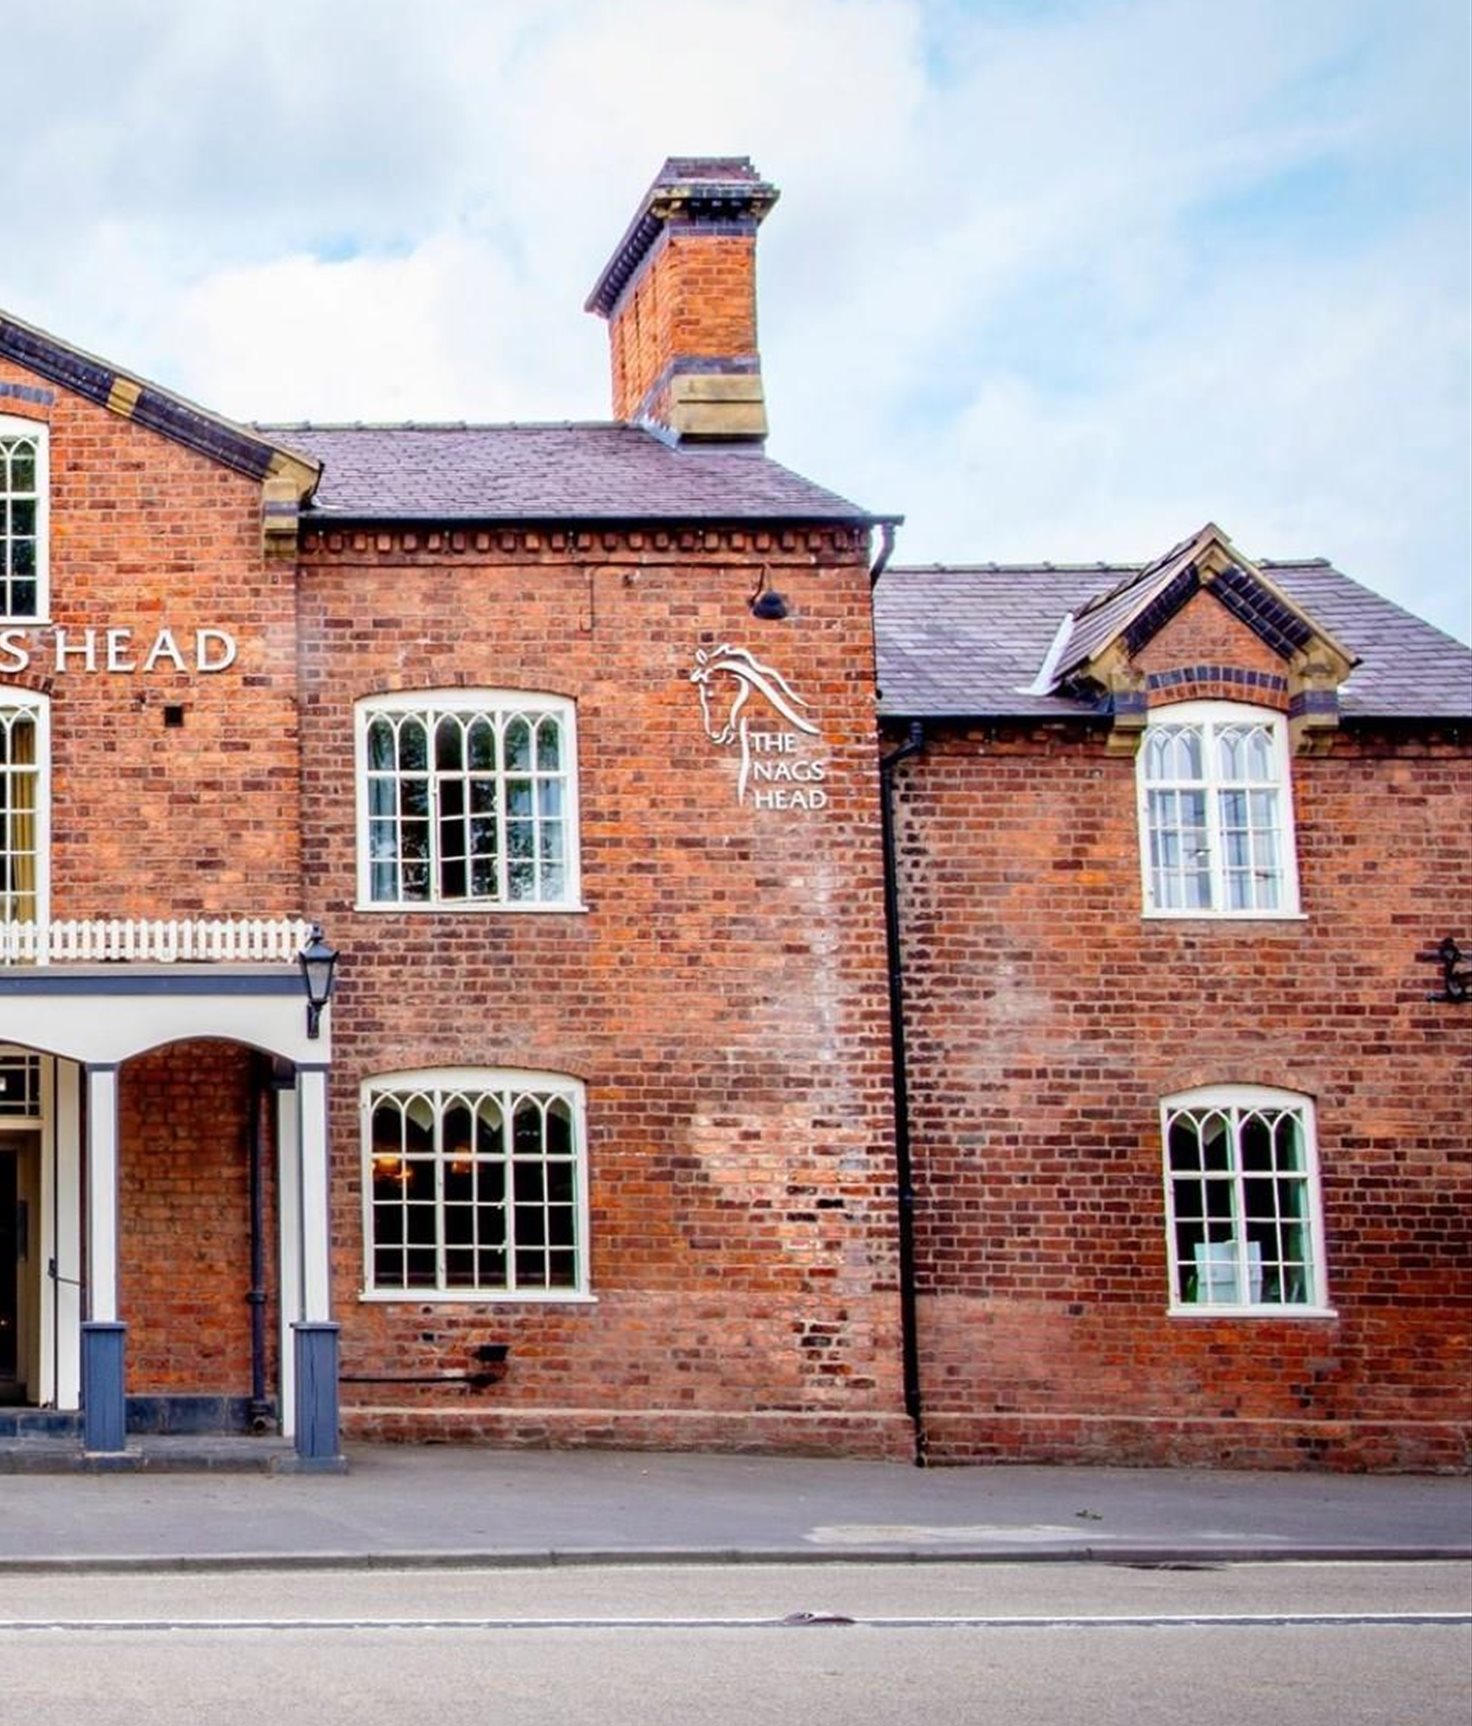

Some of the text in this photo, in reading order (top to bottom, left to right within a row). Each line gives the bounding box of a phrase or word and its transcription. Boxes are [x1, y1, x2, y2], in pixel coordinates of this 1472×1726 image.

[54, 628, 238, 674] HEAD
[750, 732, 798, 753] THE
[753, 760, 826, 782] NAGS
[754, 789, 827, 810] HEAD
